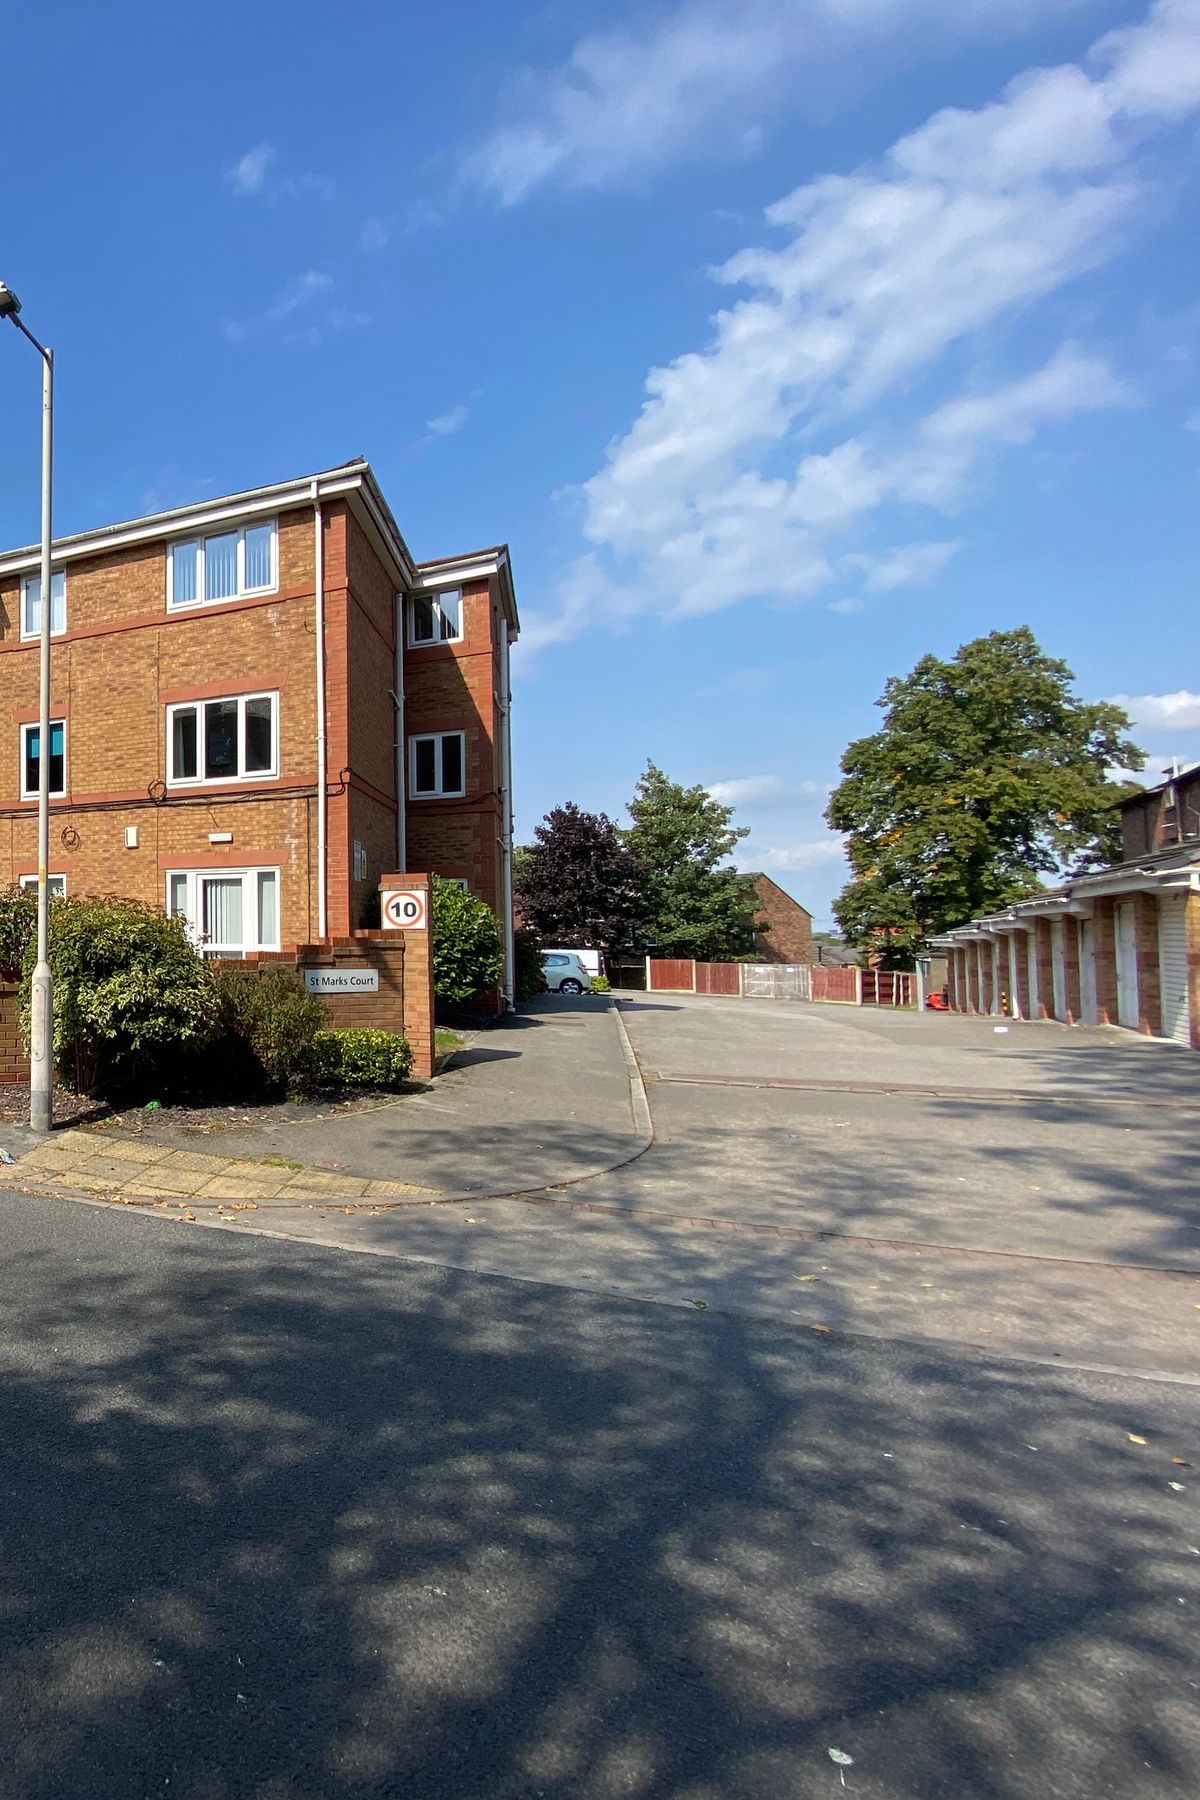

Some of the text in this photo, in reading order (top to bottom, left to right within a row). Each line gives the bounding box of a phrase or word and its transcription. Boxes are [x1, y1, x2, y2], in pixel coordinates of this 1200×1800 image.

[391, 902, 417, 917] 10
[310, 976, 374, 986] St Marks Court
